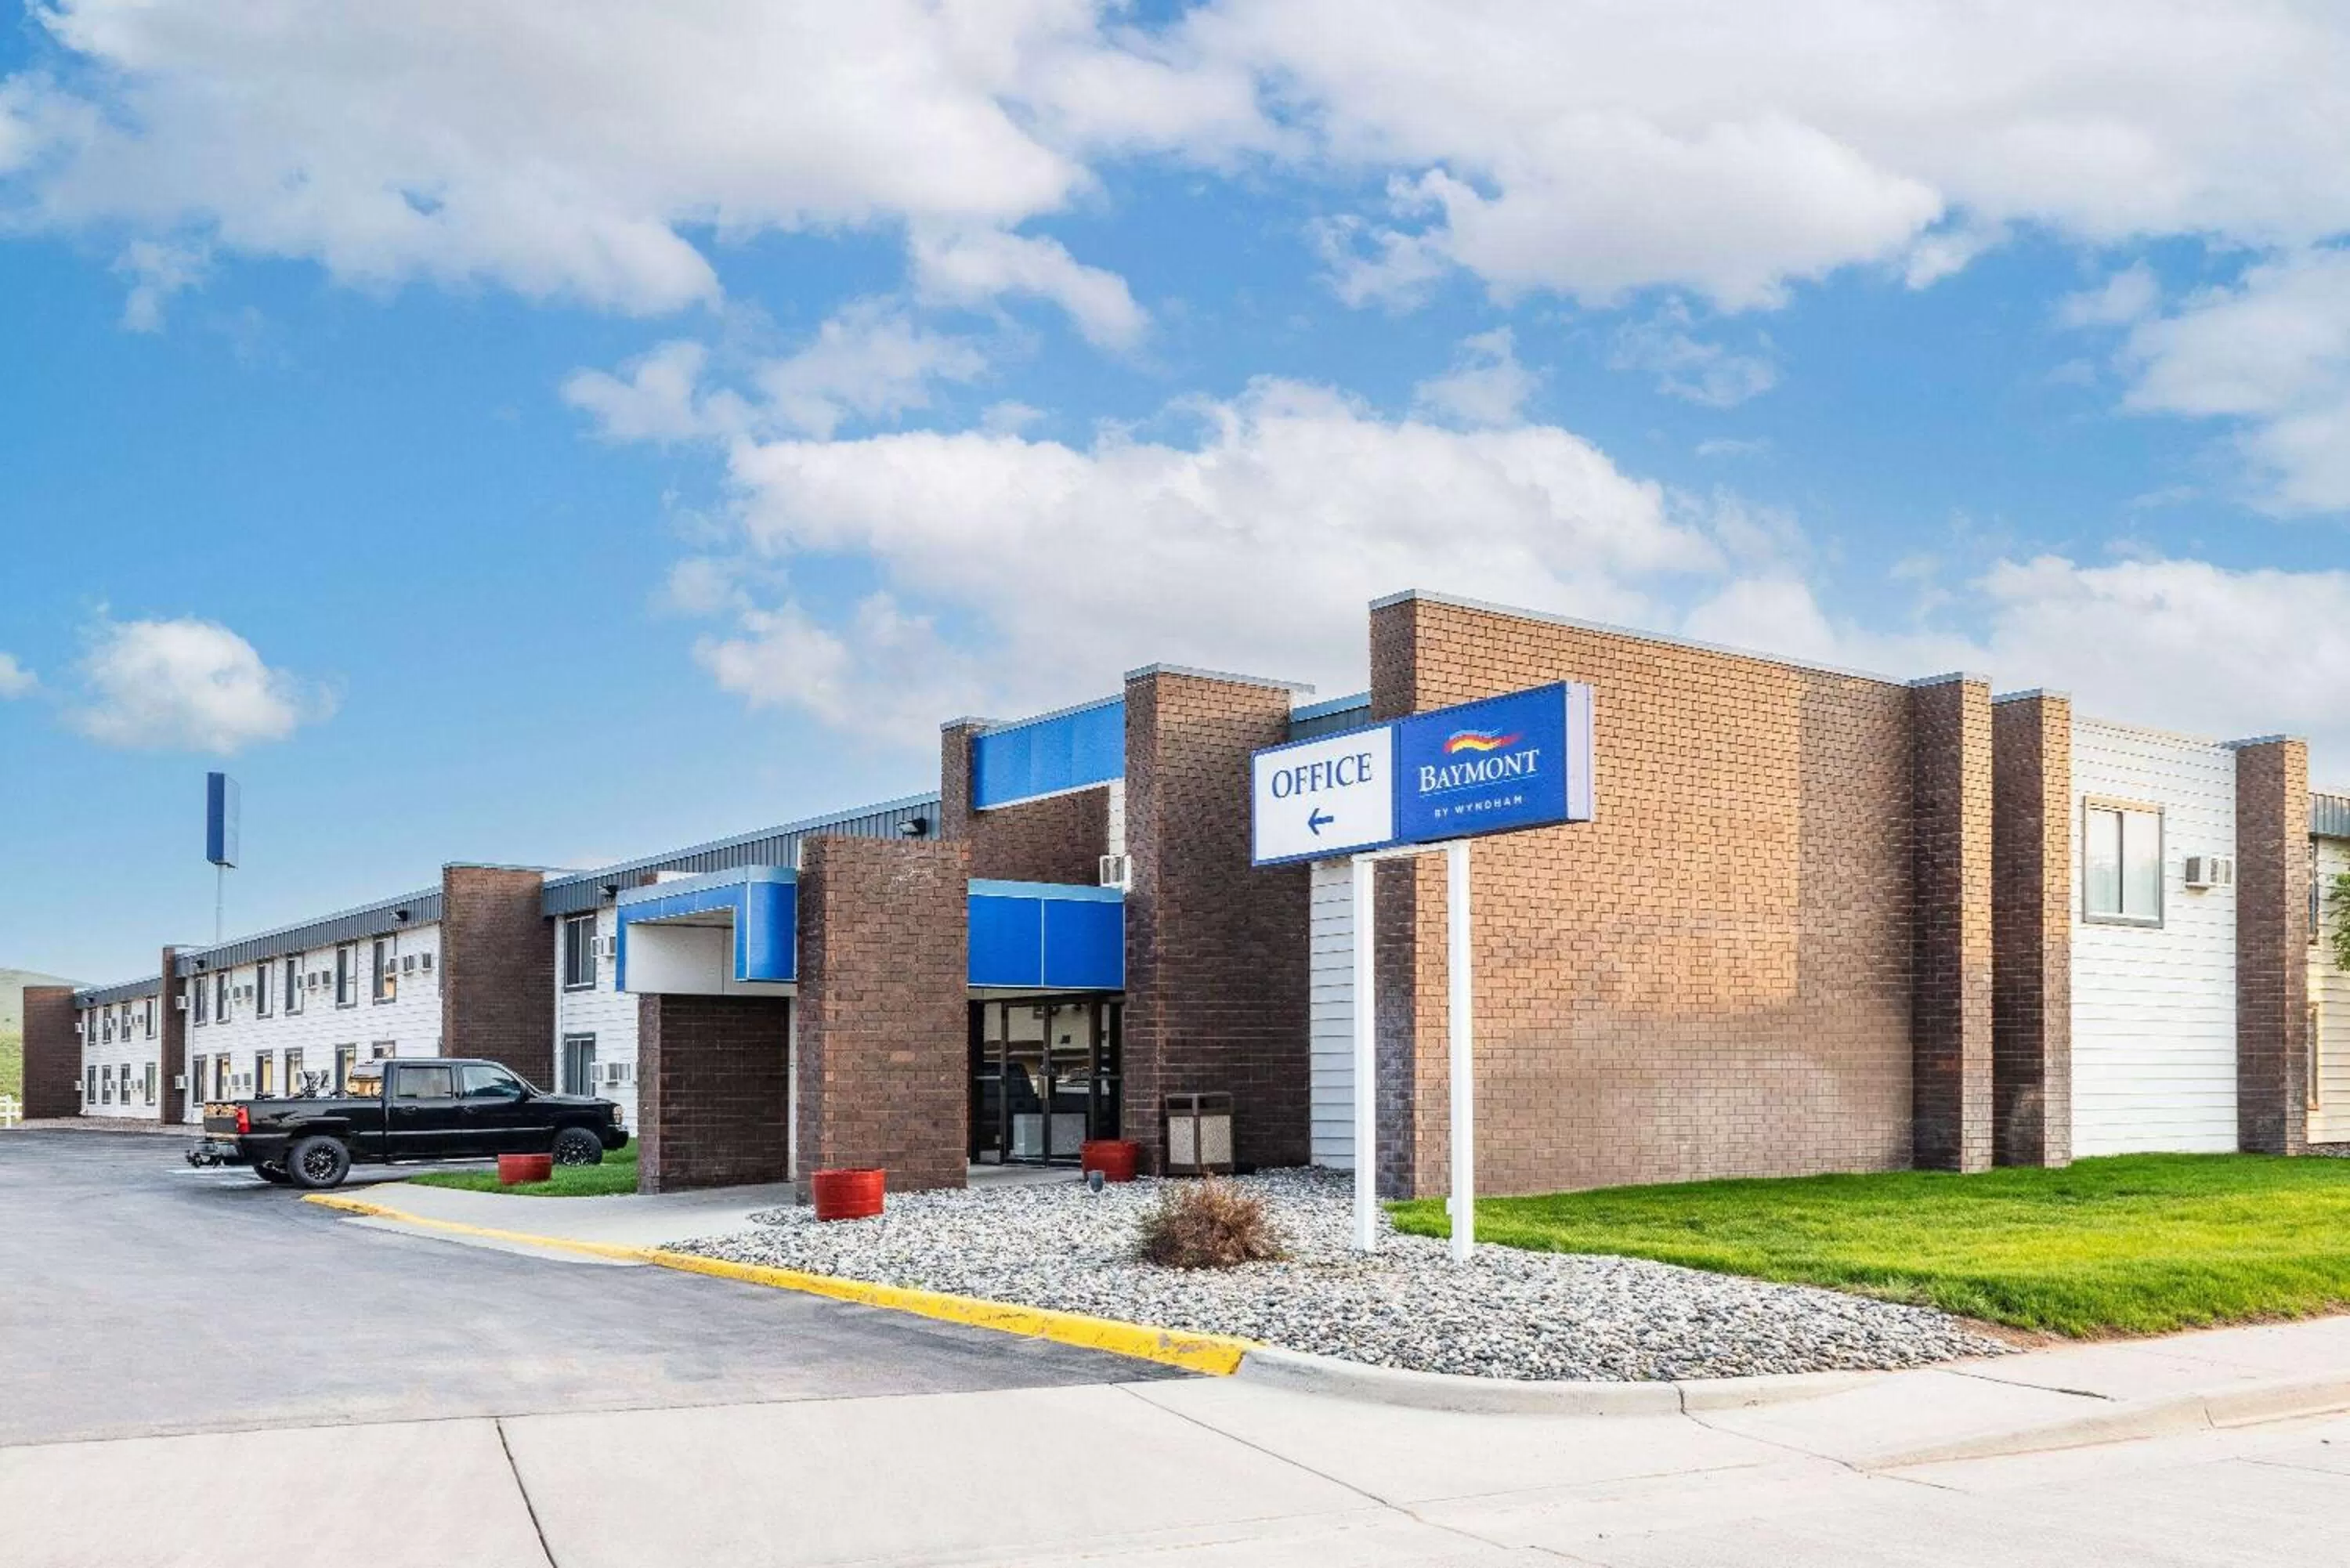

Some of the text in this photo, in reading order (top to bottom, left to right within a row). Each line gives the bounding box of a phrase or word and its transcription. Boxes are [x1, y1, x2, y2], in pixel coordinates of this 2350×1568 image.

[1271, 752, 1372, 798] OFFICE
[1418, 749, 1540, 793] BAYMONT
[1434, 795, 1523, 818] BY WYNDHAM
